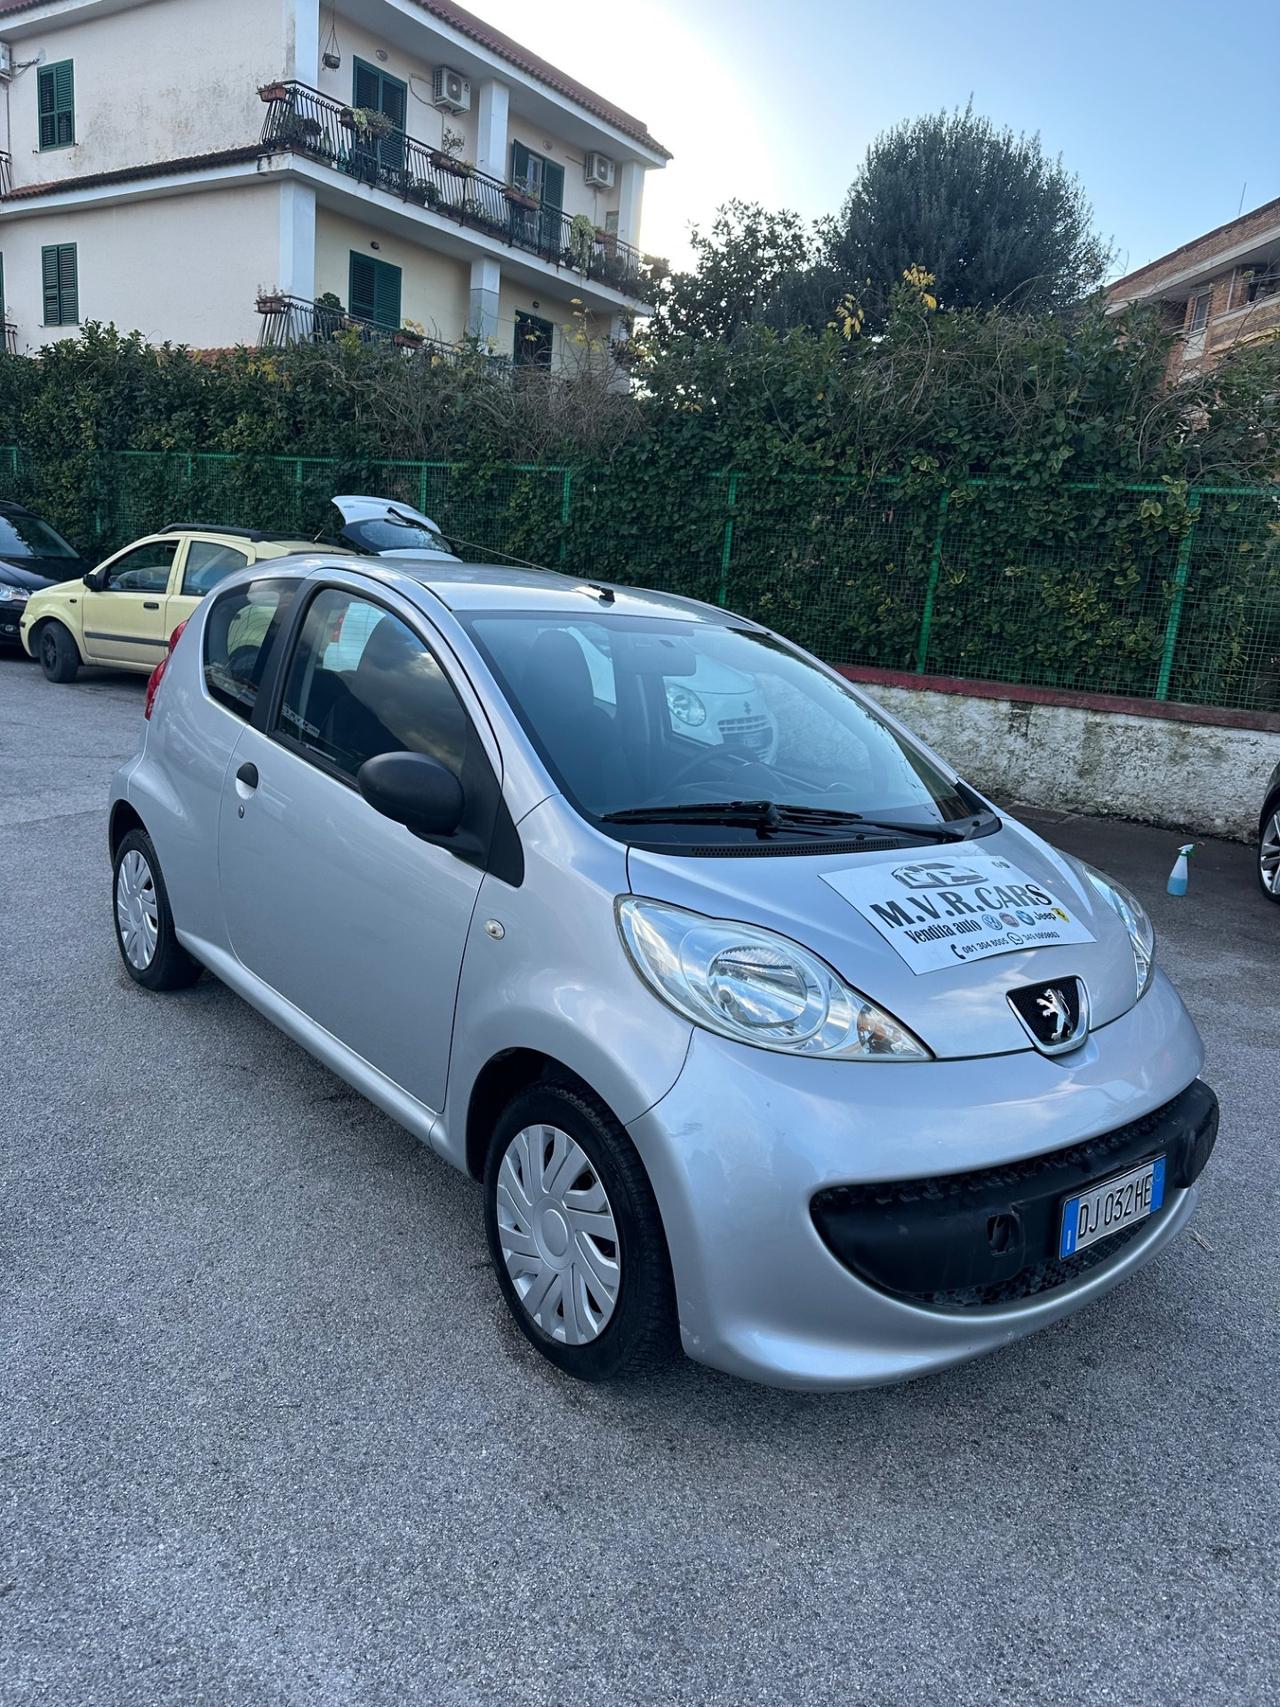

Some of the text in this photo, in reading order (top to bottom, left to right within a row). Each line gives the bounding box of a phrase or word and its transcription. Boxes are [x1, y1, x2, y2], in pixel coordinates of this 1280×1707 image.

[1033, 911, 1056, 924] Jeep
[904, 922, 953, 945] Vendita
[953, 918, 983, 934] auto
[1077, 1197, 1100, 1240] DJ
